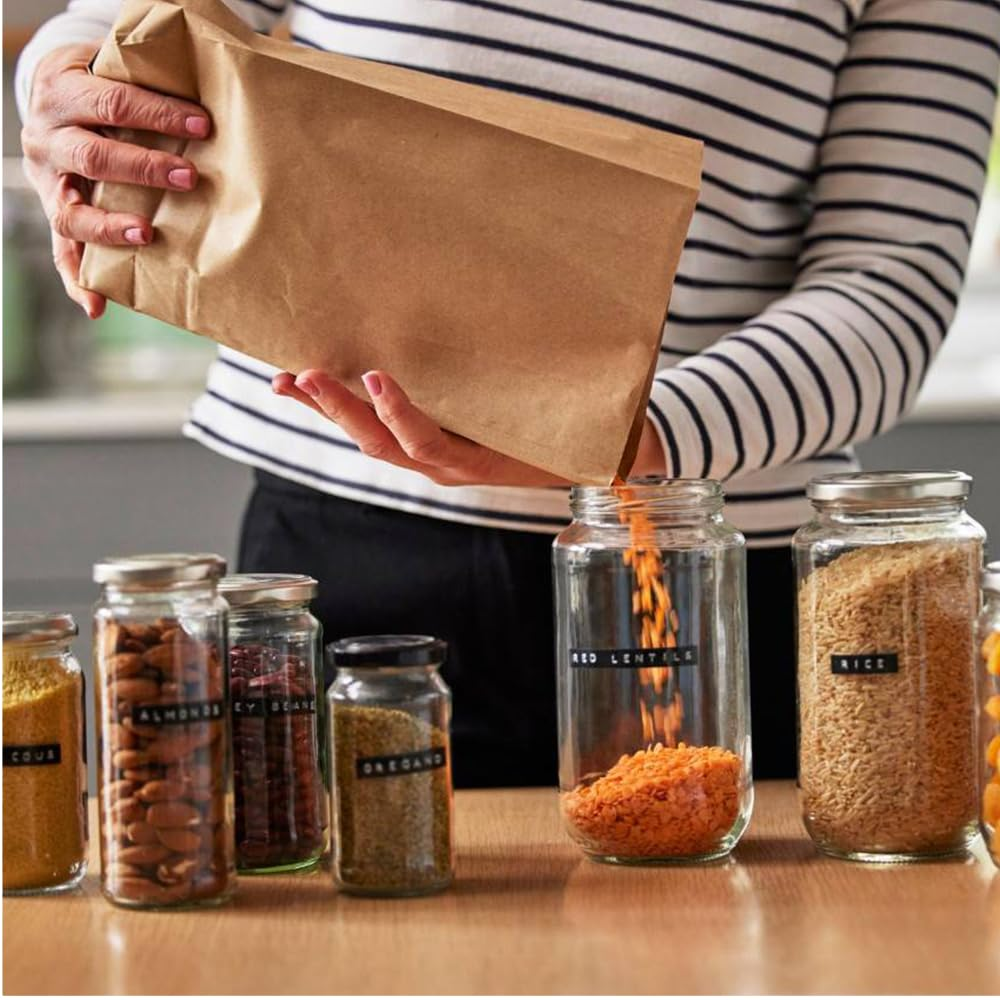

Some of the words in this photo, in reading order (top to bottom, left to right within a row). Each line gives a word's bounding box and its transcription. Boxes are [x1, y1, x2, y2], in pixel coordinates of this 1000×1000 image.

[572, 653, 598, 665] RED
[840, 658, 885, 670] RICE
[139, 703, 220, 723] ALMONDS
